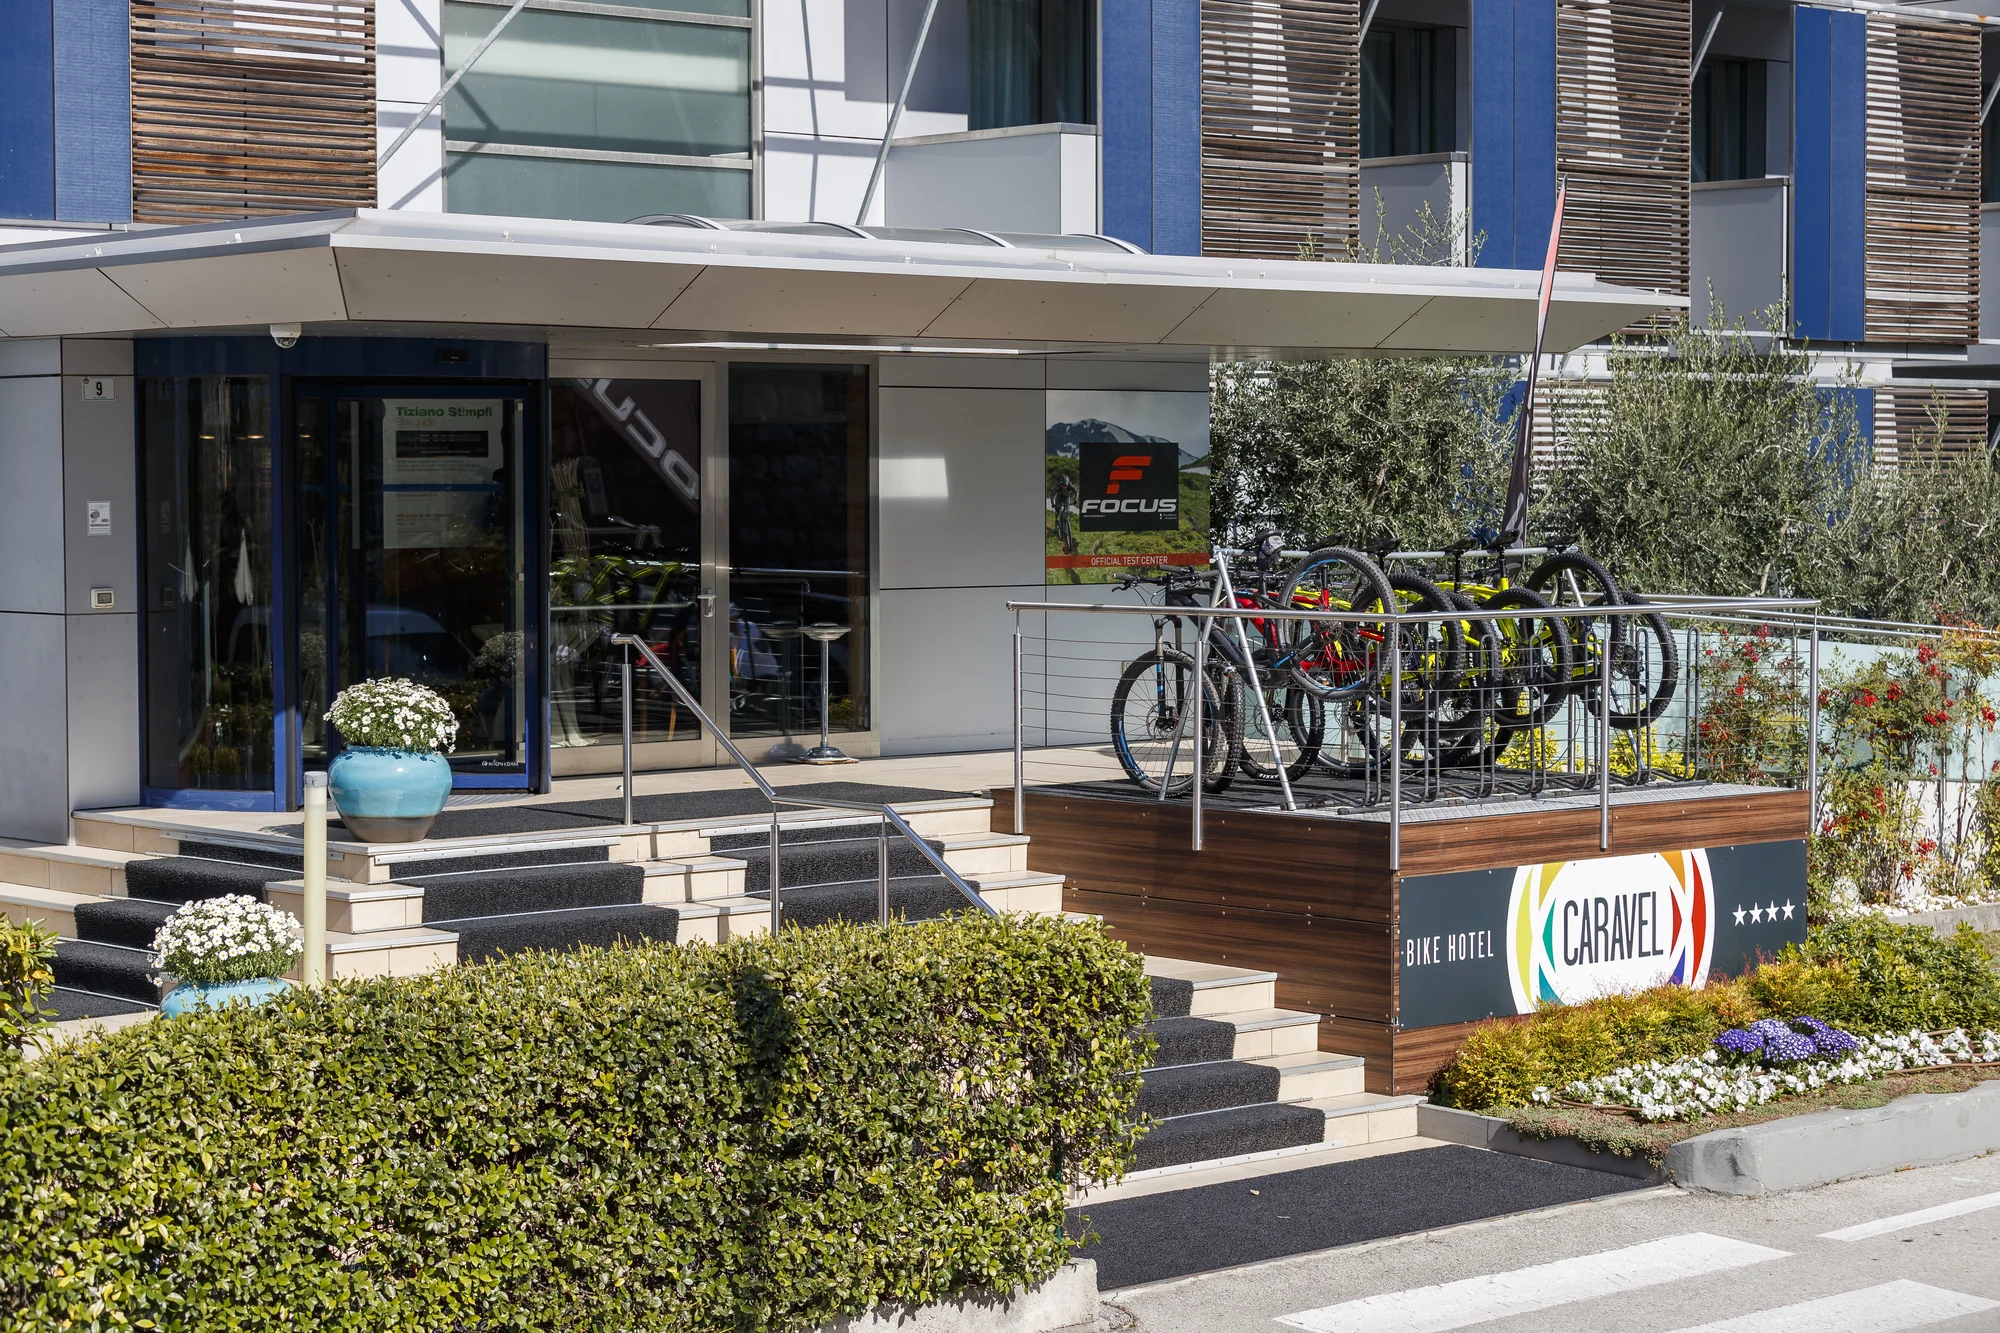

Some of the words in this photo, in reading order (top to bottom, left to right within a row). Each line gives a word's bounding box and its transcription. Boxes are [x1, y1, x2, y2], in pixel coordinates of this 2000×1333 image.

[96, 381, 103, 396] 9
[396, 407, 444, 417] Tiziano
[396, 418, 412, 426] Bike
[413, 418, 435, 427] guide
[1081, 499, 1177, 513] FOCUS
[1091, 556, 1121, 566] OFFICIAL
[1123, 556, 1140, 565] TEST
[1141, 556, 1168, 565] CENTER
[1564, 891, 1664, 967] CARAVEL
[1406, 936, 1441, 967] BIKE
[1448, 930, 1494, 963] HOTEL
